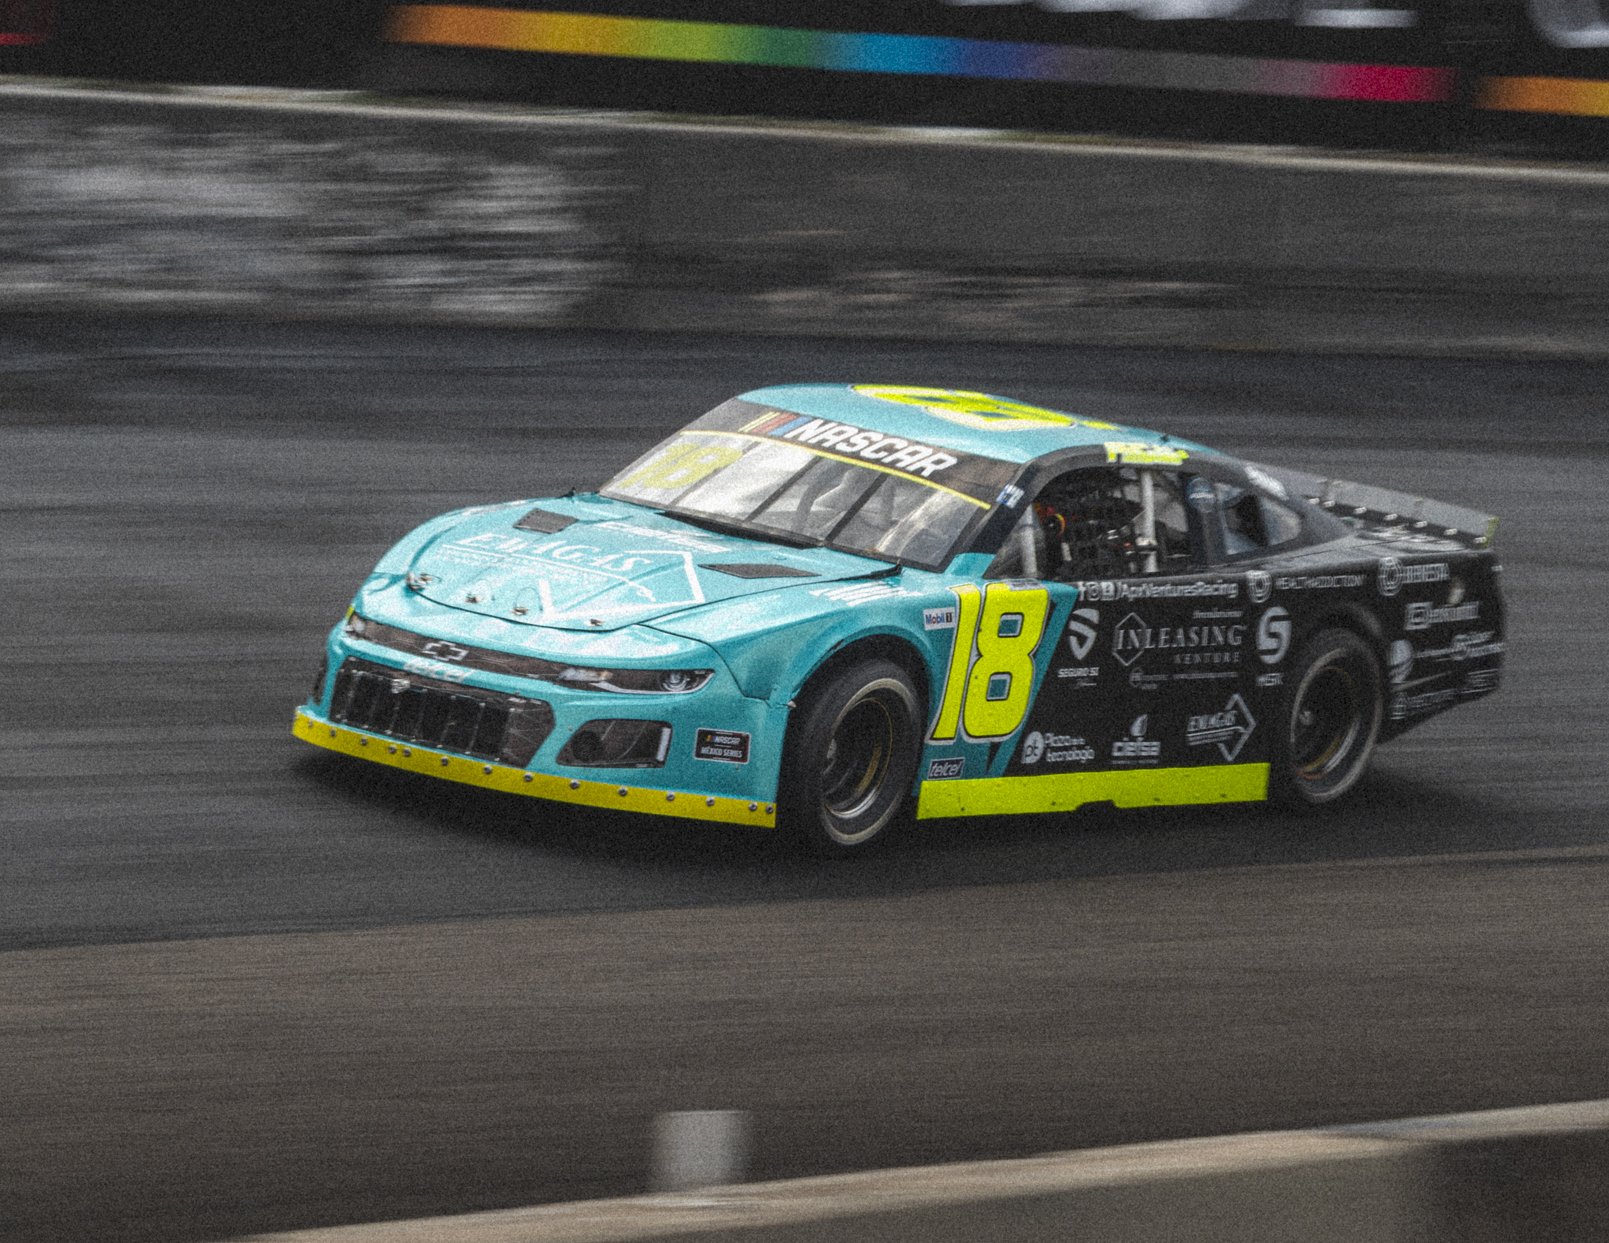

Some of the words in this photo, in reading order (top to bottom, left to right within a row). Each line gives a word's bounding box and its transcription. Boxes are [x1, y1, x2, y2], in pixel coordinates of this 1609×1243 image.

[783, 418, 957, 477] NASCAR
[617, 443, 743, 489] 18
[925, 612, 945, 625] Mobil
[925, 583, 1049, 744] 18
[713, 736, 741, 745] NASCAR
[929, 763, 961, 778] telcel
